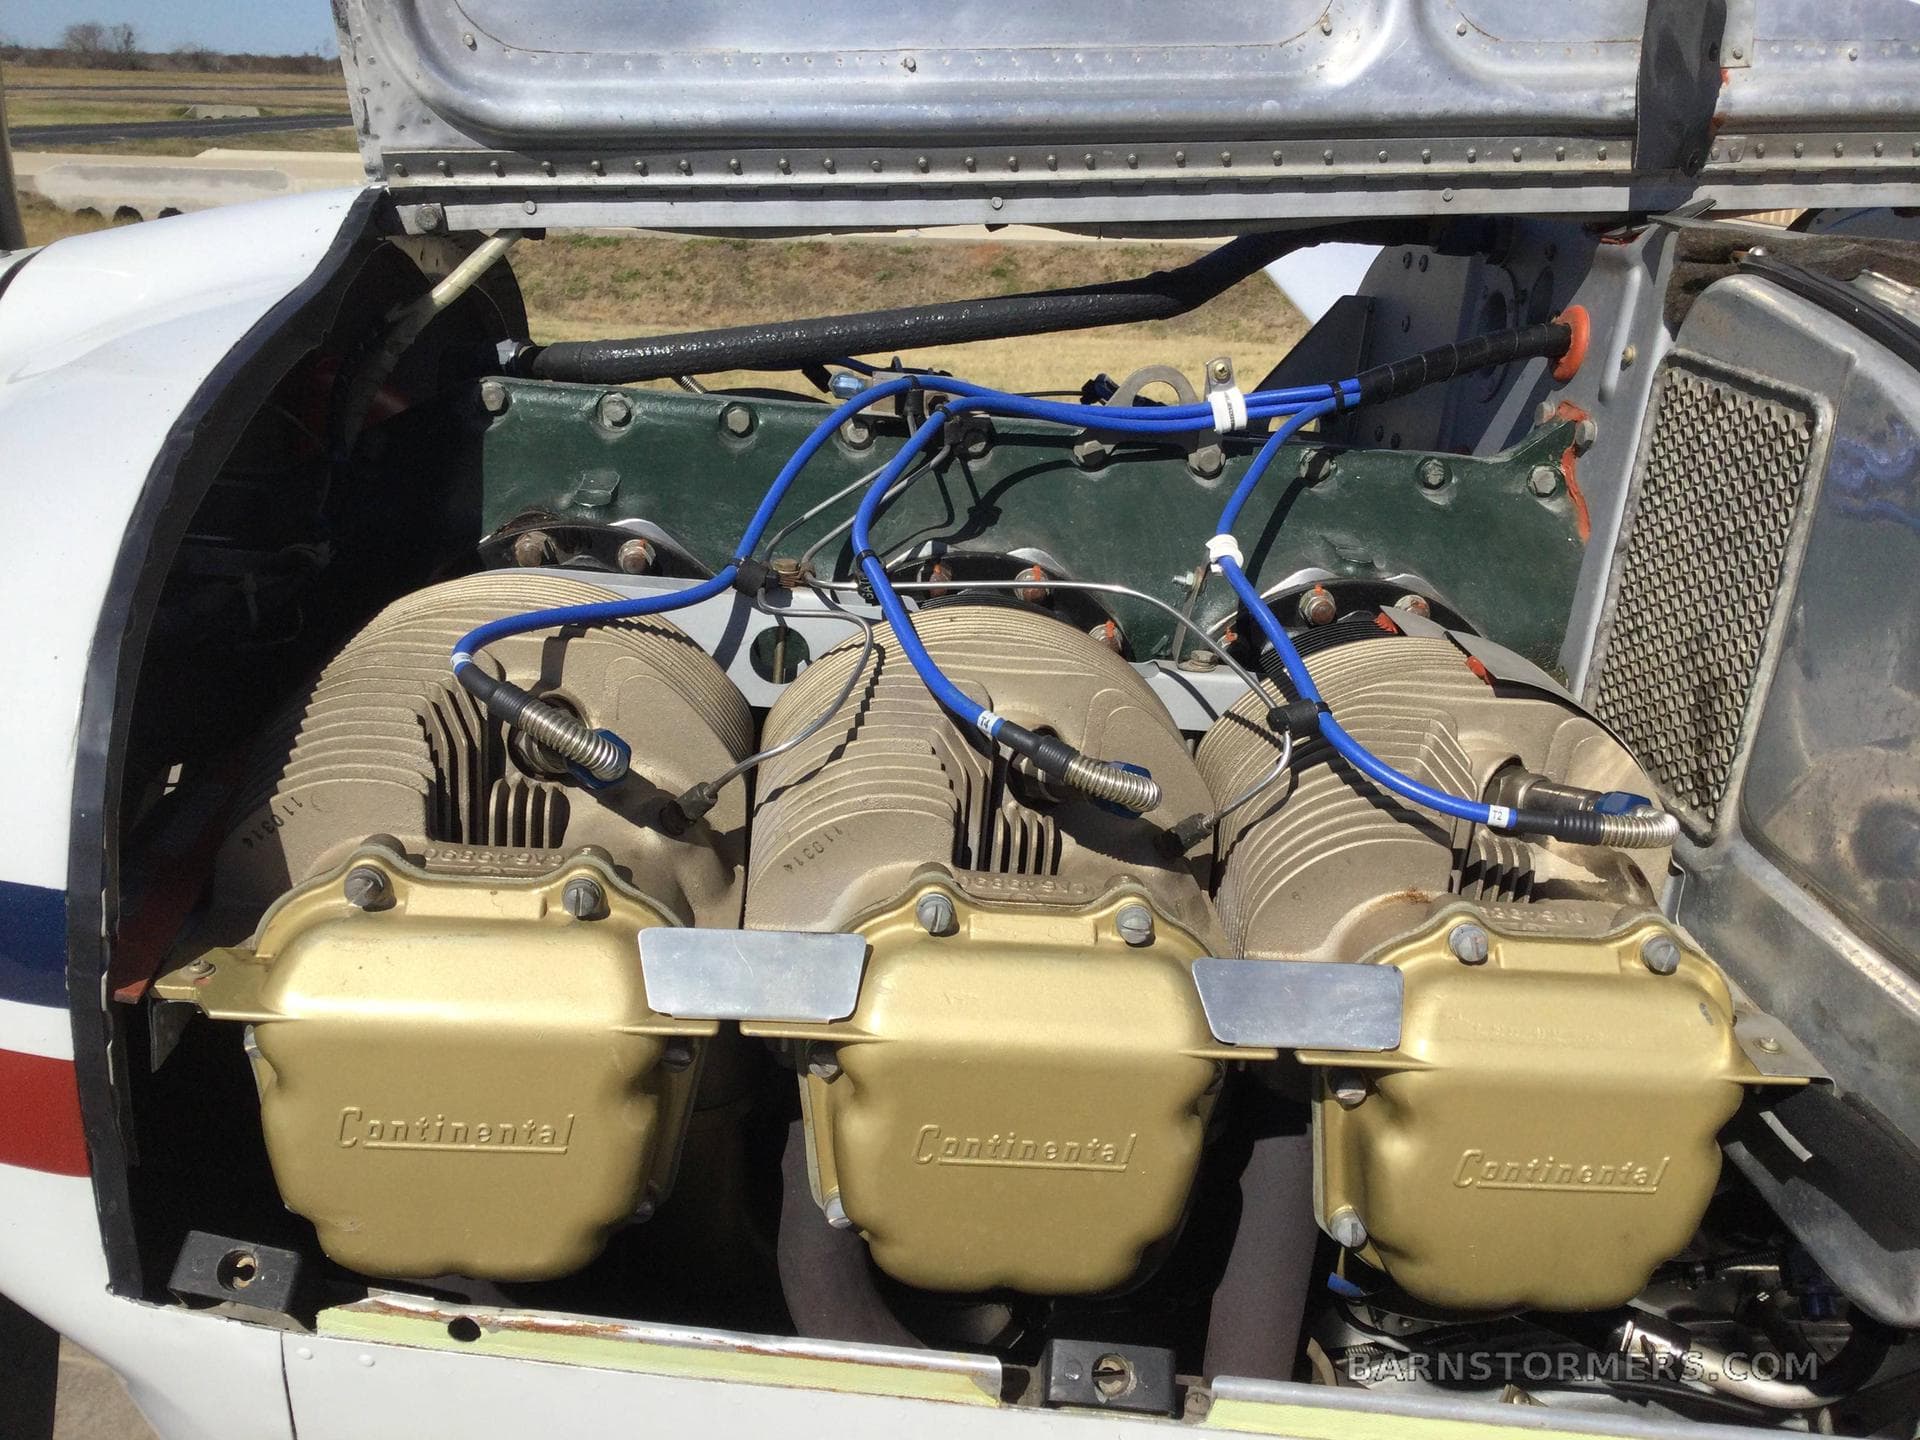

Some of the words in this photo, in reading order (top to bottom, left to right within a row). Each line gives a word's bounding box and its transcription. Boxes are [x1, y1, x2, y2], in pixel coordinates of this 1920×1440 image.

[1492, 809, 1504, 821] T2
[339, 1106, 575, 1149] Continental
[912, 1124, 1138, 1165] Continental
[1453, 1149, 1671, 1189] Continental
